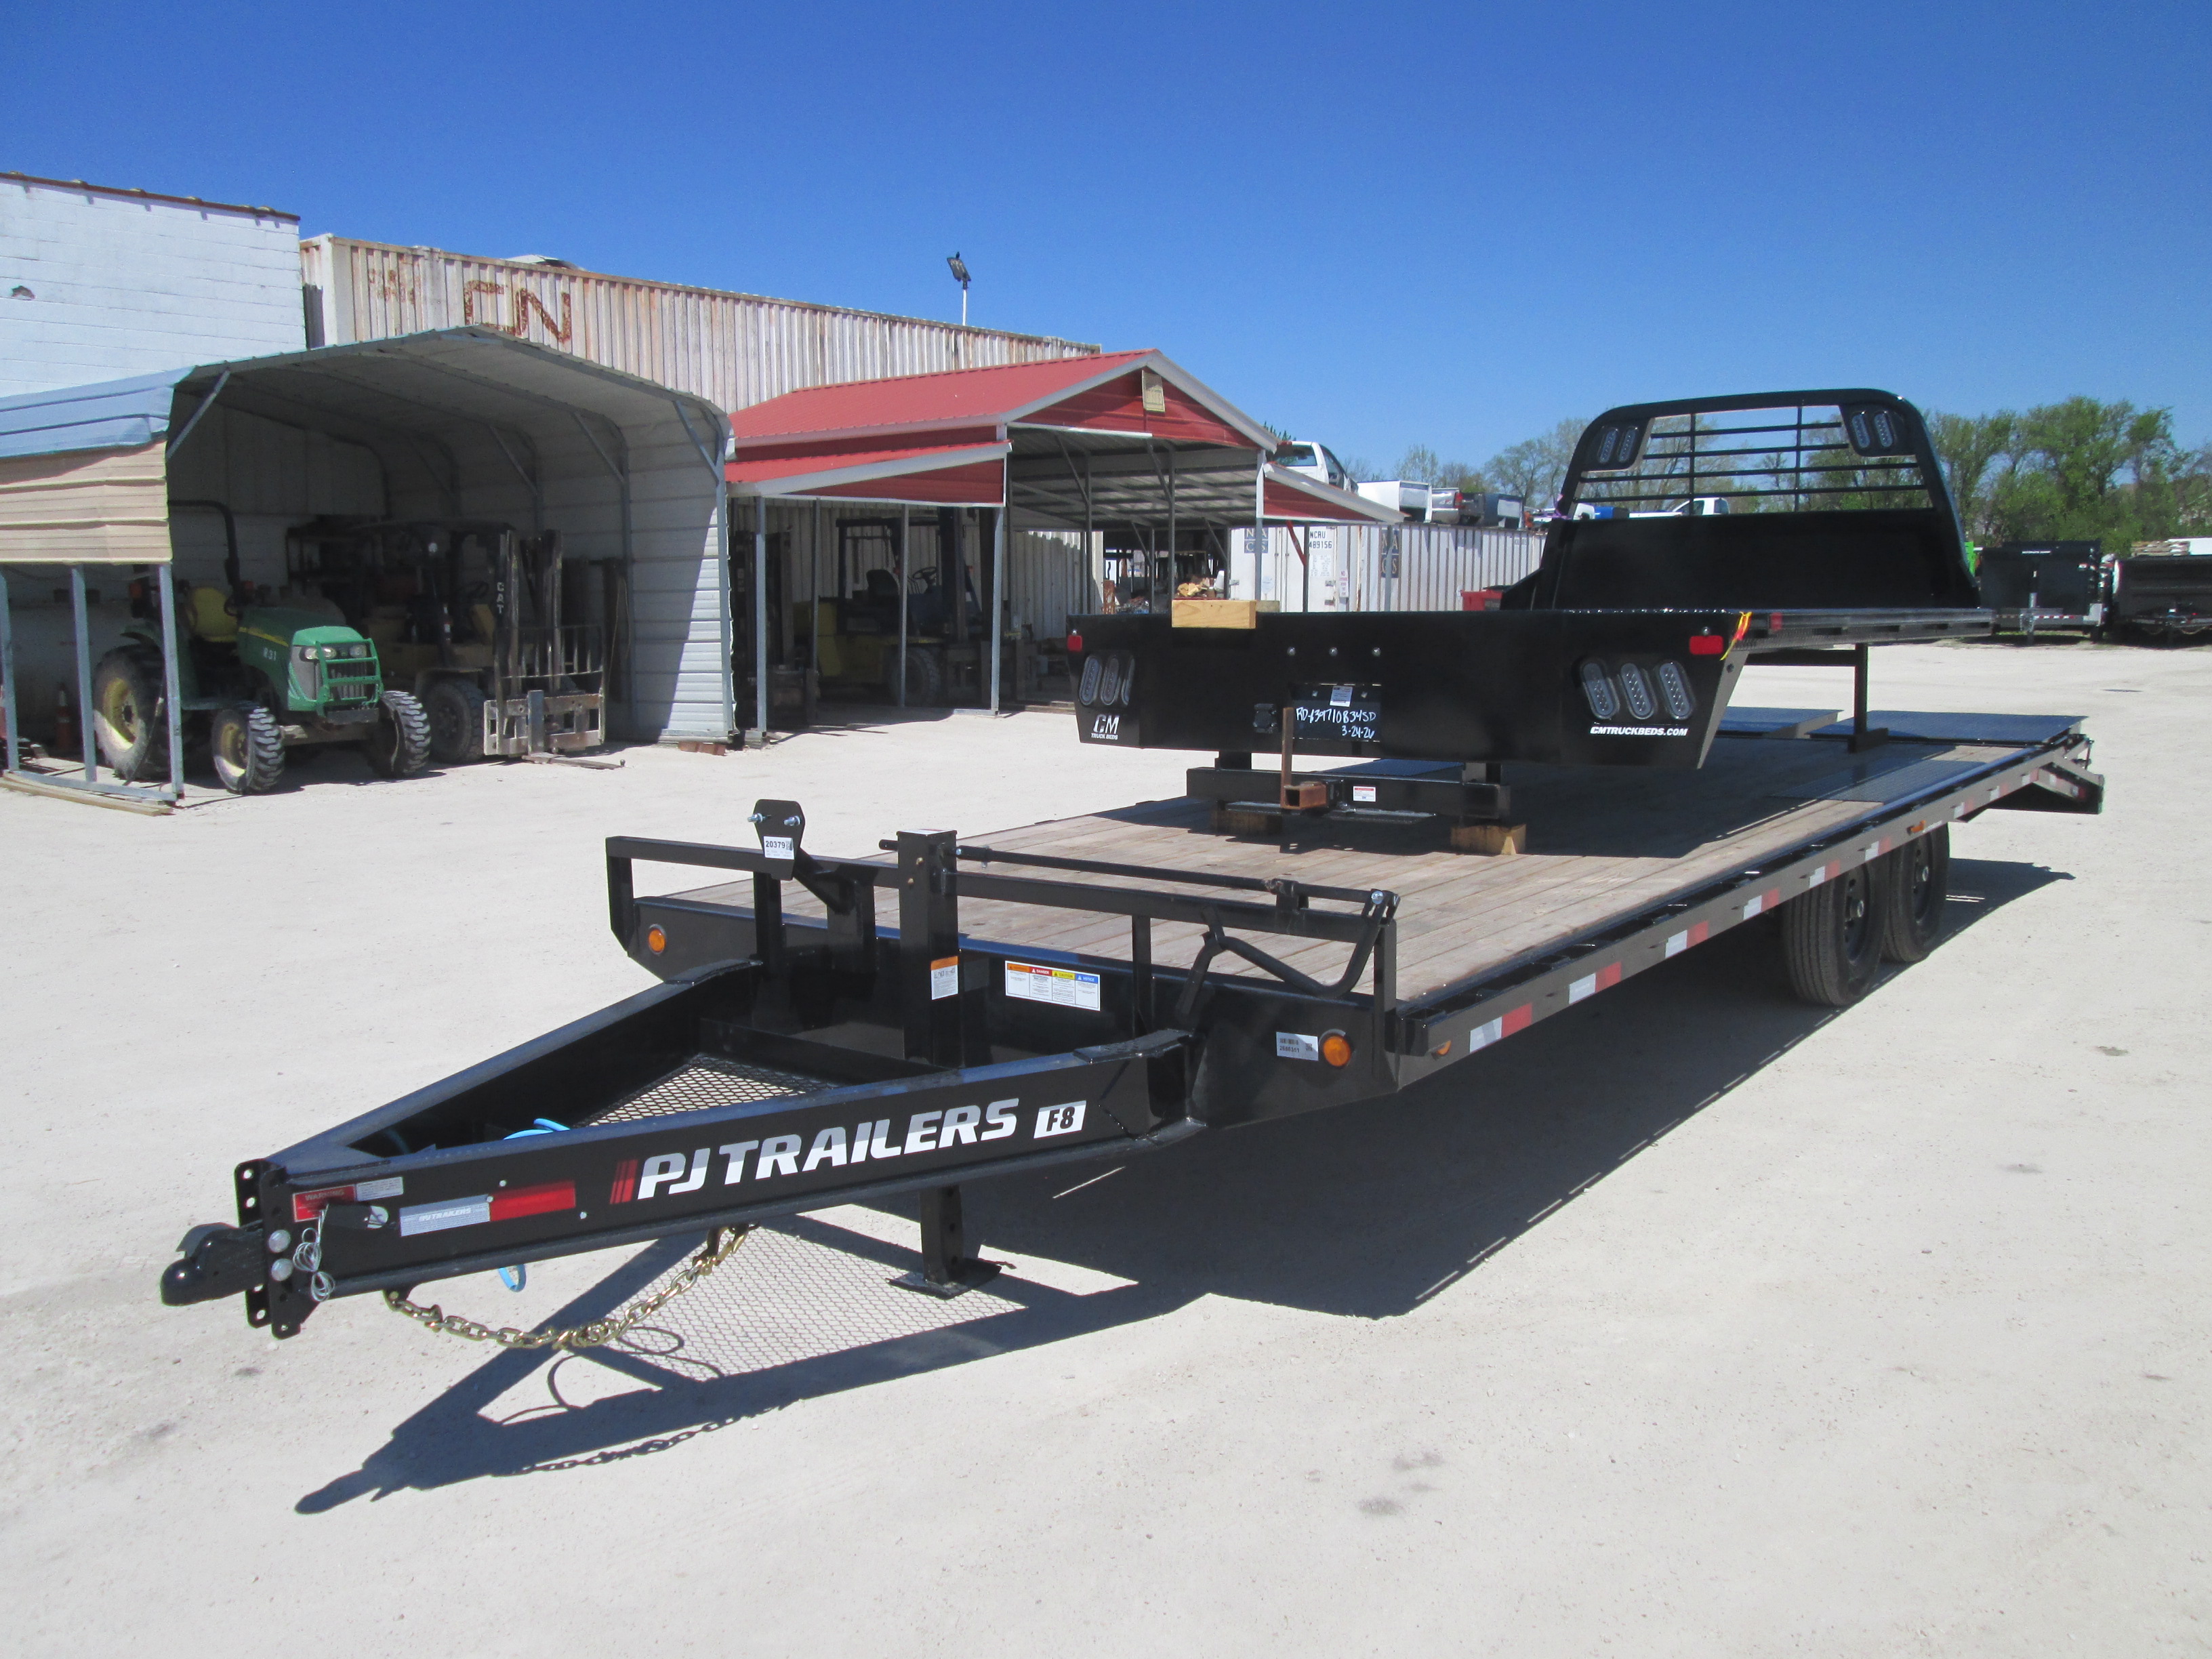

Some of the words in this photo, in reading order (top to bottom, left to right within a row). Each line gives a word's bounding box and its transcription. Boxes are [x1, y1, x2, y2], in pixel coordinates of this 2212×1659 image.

[1093, 714, 1120, 734] CM
[1590, 726, 1688, 736] CMTRUCKBEDS.COM
[765, 840, 785, 848] 20379
[1046, 1106, 1076, 1132] F8
[638, 1148, 711, 1200] PJ
[719, 1098, 1019, 1185] TRAILERS
[306, 1189, 345, 1201] WARNING
